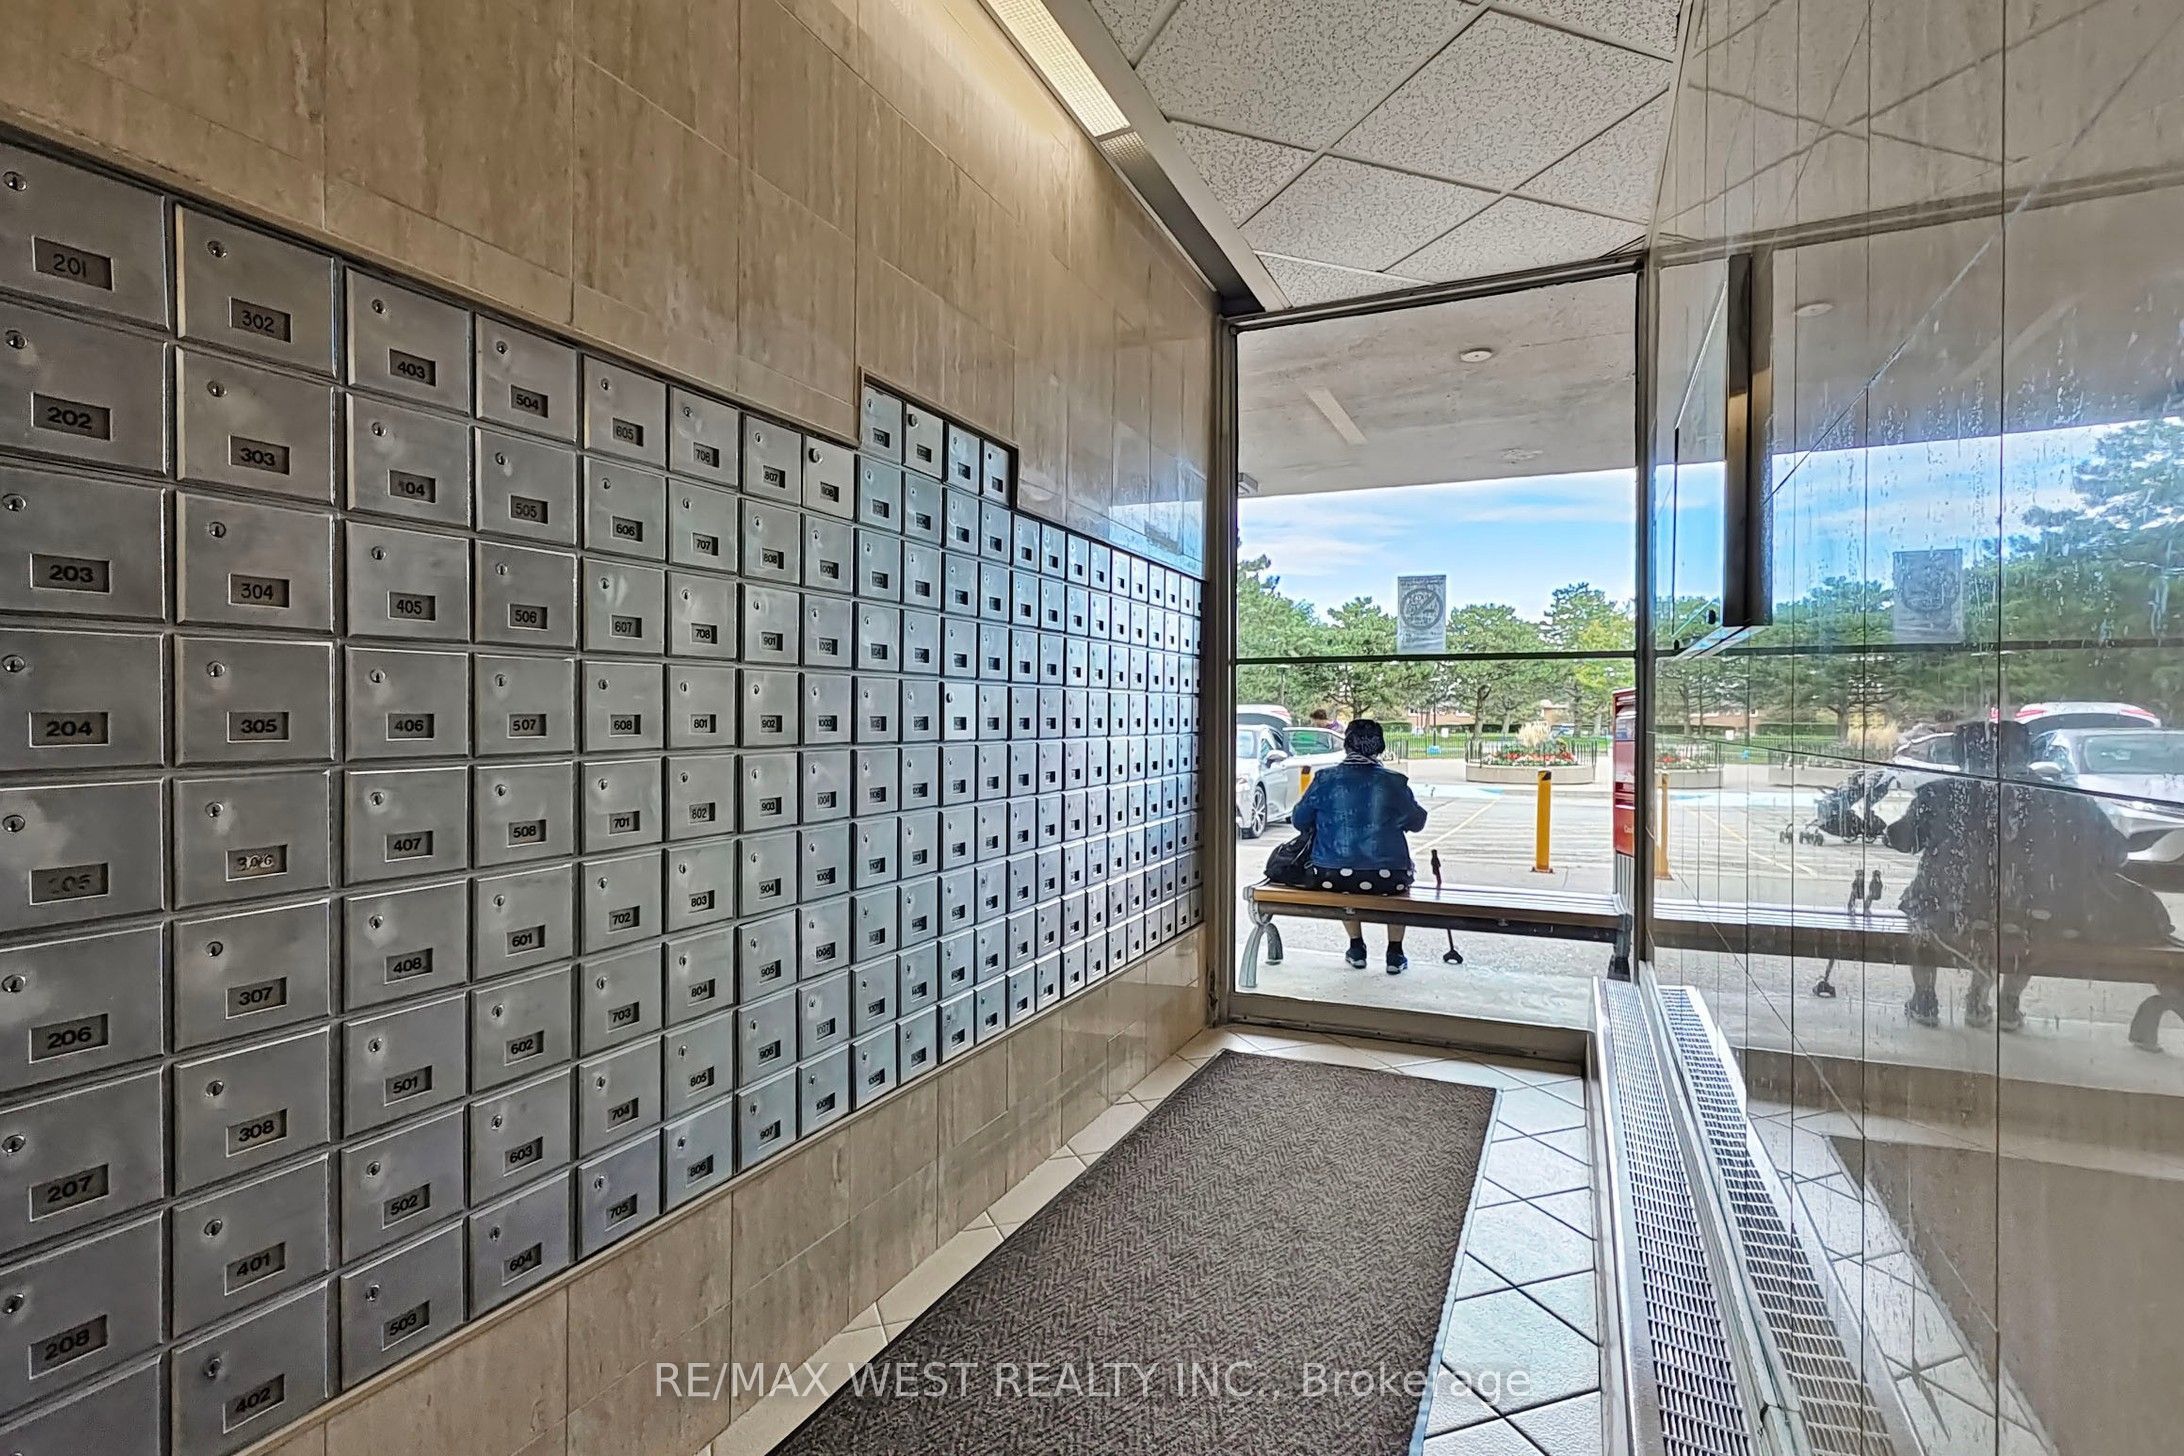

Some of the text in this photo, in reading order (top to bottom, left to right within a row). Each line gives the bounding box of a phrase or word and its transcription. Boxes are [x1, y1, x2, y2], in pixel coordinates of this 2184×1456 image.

[53, 254, 87, 277] 201
[241, 310, 274, 333] 302
[397, 361, 426, 379] 403
[516, 395, 539, 409] 504
[48, 407, 92, 429] 202
[616, 425, 634, 440] 605
[240, 447, 275, 467] 303
[398, 481, 426, 497] 04
[515, 503, 537, 518] 505
[616, 524, 635, 536] 606
[696, 539, 711, 551] 707
[49, 564, 93, 583] 203
[240, 582, 273, 600] 304
[396, 599, 423, 614] 405
[515, 609, 537, 624] 506
[615, 620, 632, 633] 607
[695, 628, 711, 639] 708
[762, 636, 776, 646] 901
[46, 721, 93, 737] 204
[240, 719, 277, 733] 305
[394, 719, 424, 732] 406
[512, 719, 537, 731] 507
[613, 719, 632, 731] 608
[693, 719, 708, 729] 801
[761, 719, 776, 729] 902
[761, 802, 775, 811] 903
[613, 816, 630, 828] 701
[512, 825, 537, 838] 508
[394, 838, 421, 852] 407
[236, 854, 272, 870] 306
[760, 884, 774, 894] 904
[691, 896, 707, 907] 803
[612, 912, 631, 924] 702
[511, 932, 532, 947] 601
[393, 957, 422, 973] 408
[760, 965, 775, 976] 905
[239, 987, 272, 1005] 307
[691, 985, 708, 998] 804
[612, 1008, 631, 1020] 703
[48, 1027, 92, 1049] 206
[510, 1038, 534, 1055] 602
[392, 1075, 418, 1094] 501
[690, 1074, 707, 1087] 805
[612, 1105, 630, 1120] 704
[238, 1120, 273, 1142] 308
[509, 1145, 533, 1163] 603
[689, 1162, 706, 1177] 806
[47, 1175, 95, 1202] 207
[390, 1195, 417, 1216] 502
[610, 1203, 629, 1218] 705
[236, 1253, 270, 1276] 401
[509, 1252, 533, 1271] 604
[389, 1314, 417, 1336] 503
[44, 1328, 90, 1360] 208
[235, 1388, 270, 1413] 402
